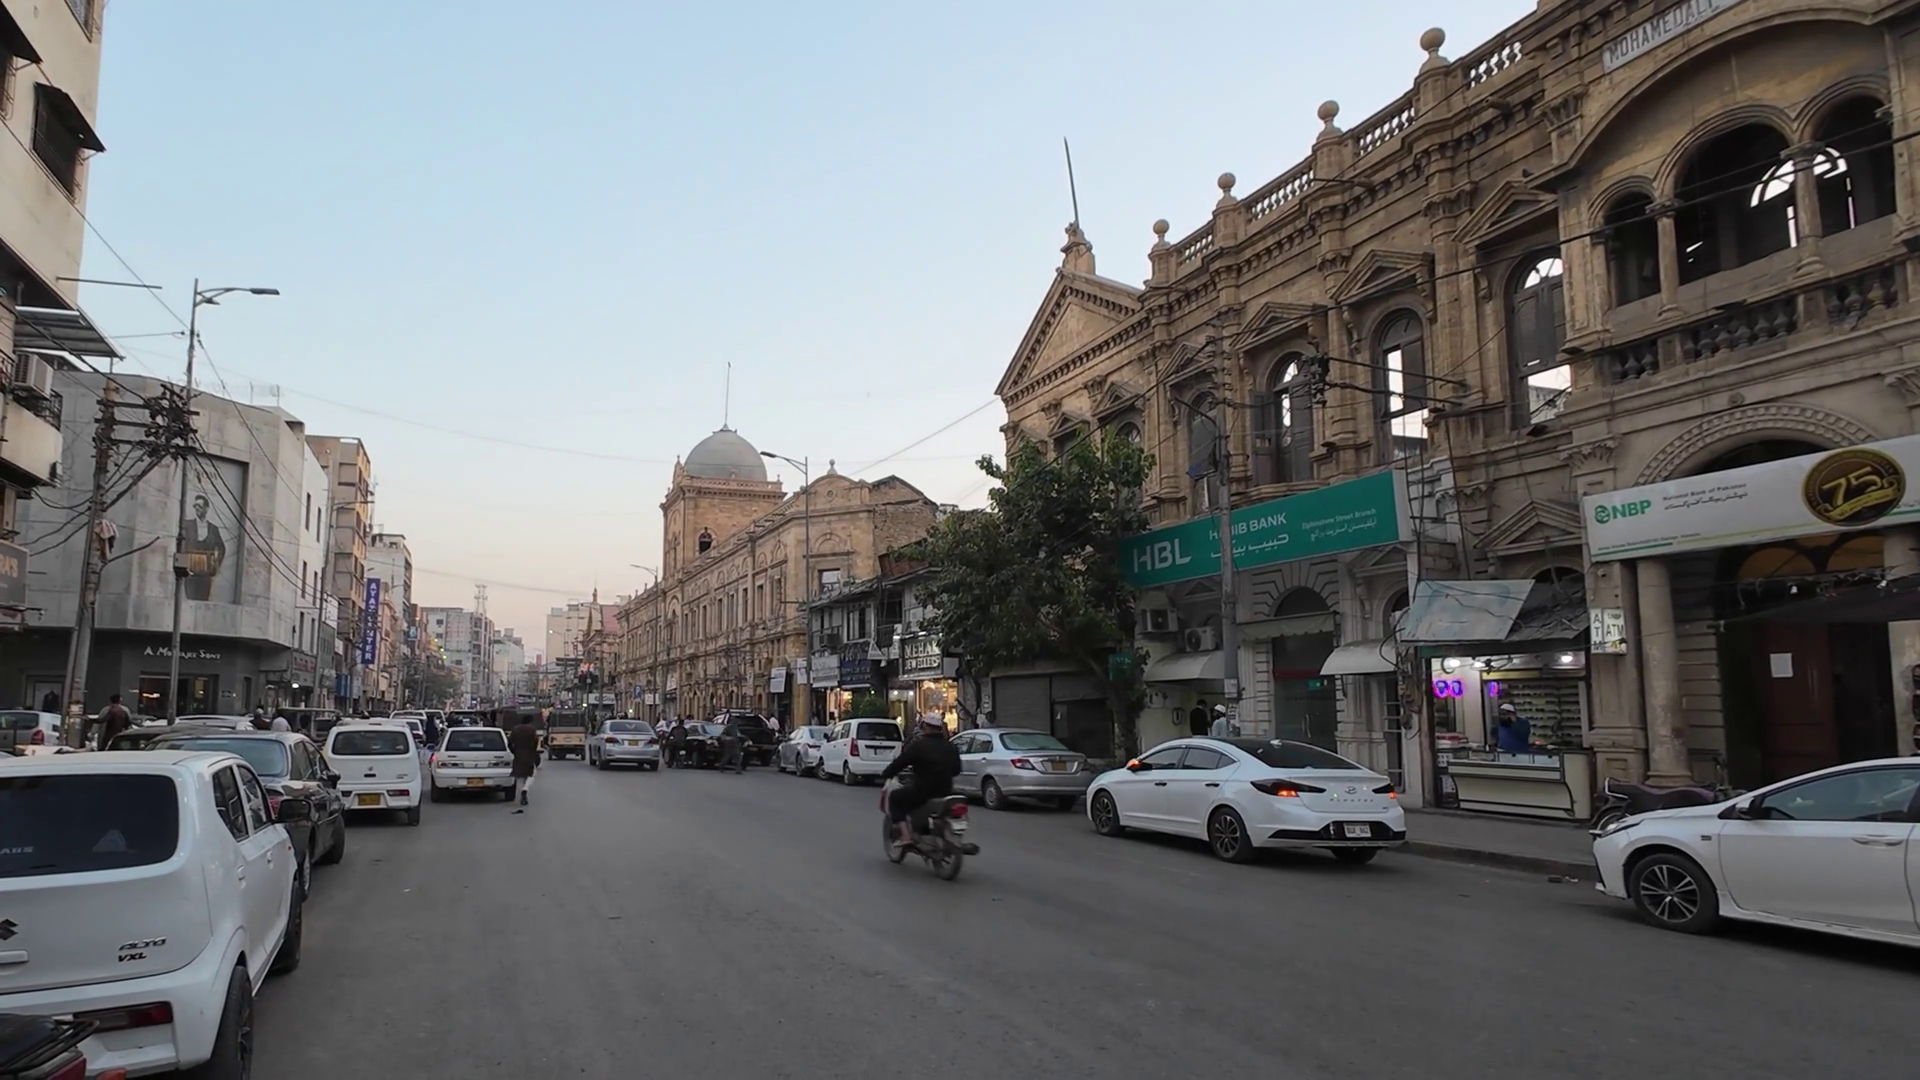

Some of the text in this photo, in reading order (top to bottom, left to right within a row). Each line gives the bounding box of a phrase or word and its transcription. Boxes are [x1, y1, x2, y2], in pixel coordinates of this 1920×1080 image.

[1821, 466, 1882, 508] 75
[1335, 512, 1354, 523] Street
[1355, 507, 1377, 518] Branch
[1611, 499, 1652, 520] NBP
[1250, 512, 1288, 532] BANK
[1133, 538, 1193, 574] HBL
[1606, 624, 1624, 637] ATM
[118, 936, 167, 951] ALTO
[118, 952, 147, 963] VXL
